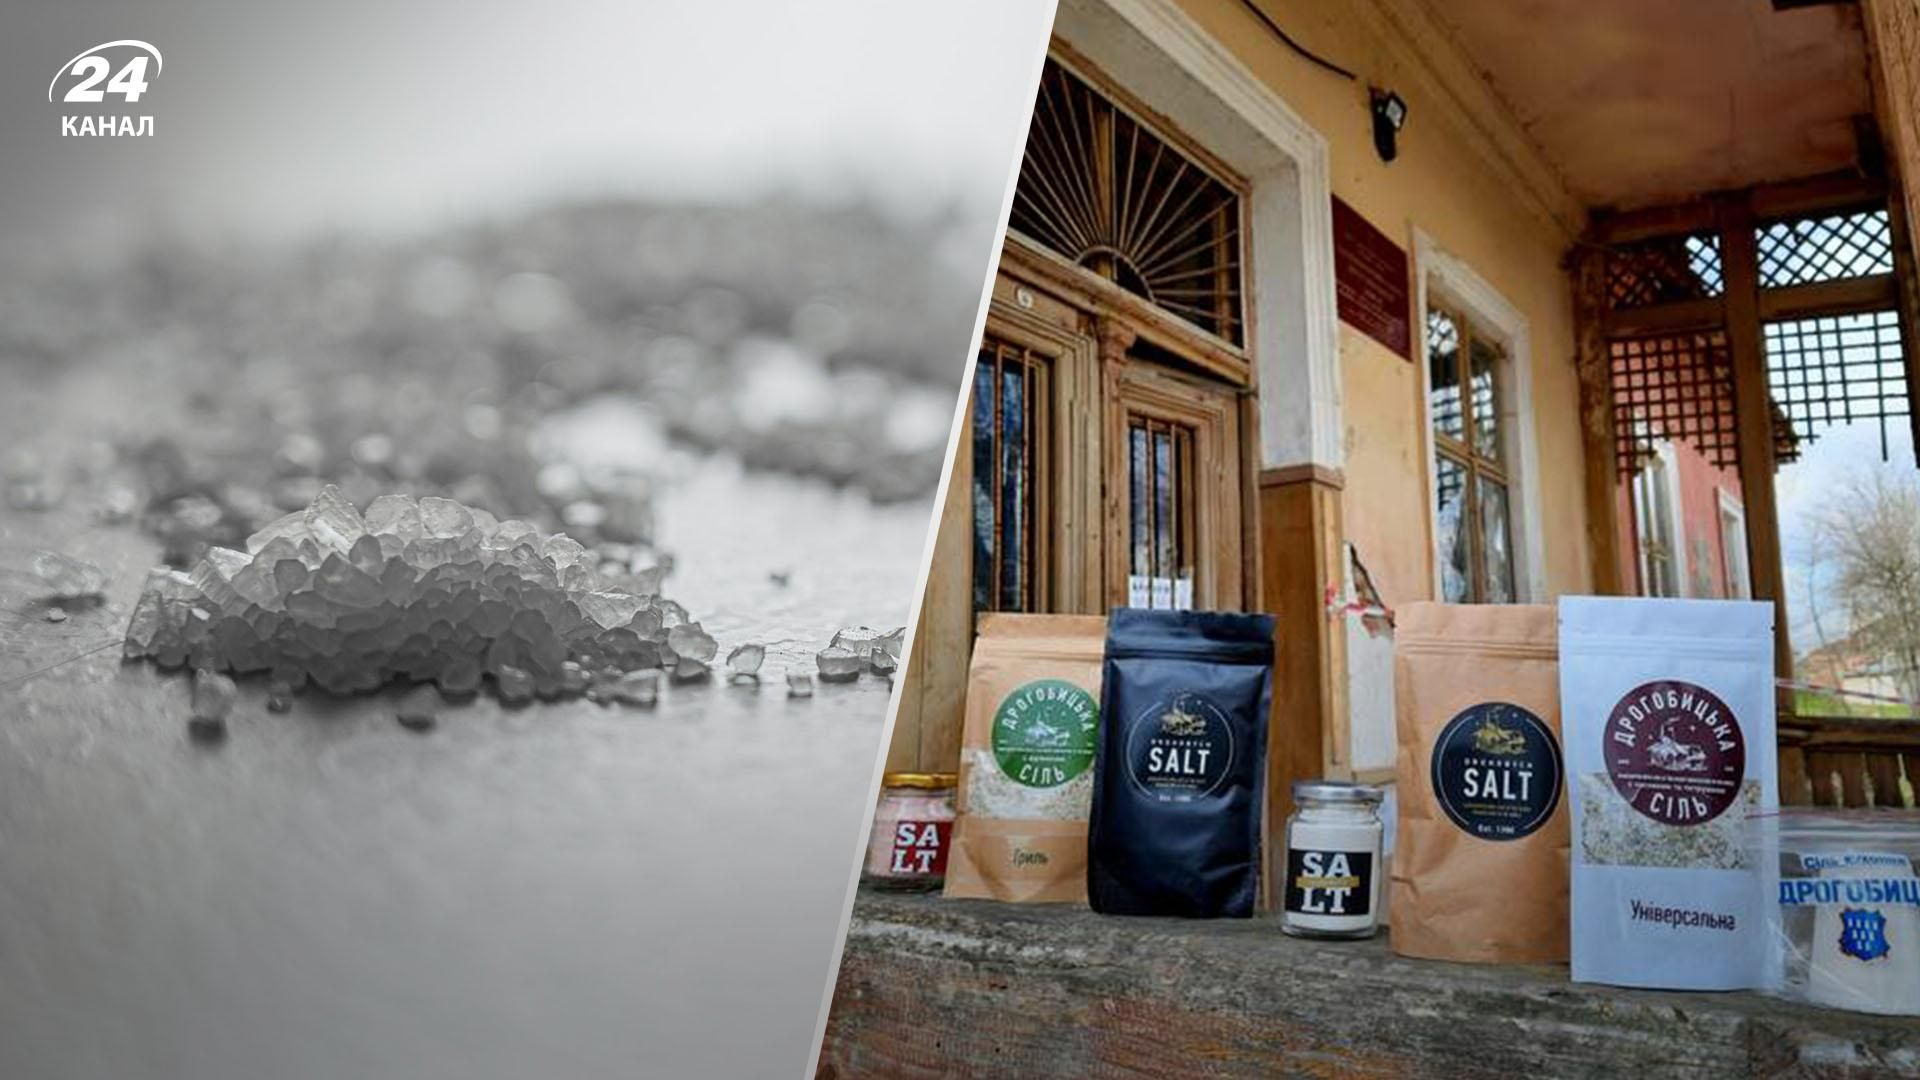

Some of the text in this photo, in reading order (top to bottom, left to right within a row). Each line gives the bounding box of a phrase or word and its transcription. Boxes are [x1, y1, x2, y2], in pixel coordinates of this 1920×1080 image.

[1001, 687, 1096, 732] ДРОГОБИЦЬКА
[1614, 690, 1736, 752] ДРОГОБИЦЬКА
[1019, 764, 1066, 785] СІЛЬ
[1148, 746, 1211, 775] SALT
[1463, 767, 1533, 801] SALT
[1649, 792, 1708, 819] СІЛЬ
[1630, 899, 1737, 931] Універсальна
